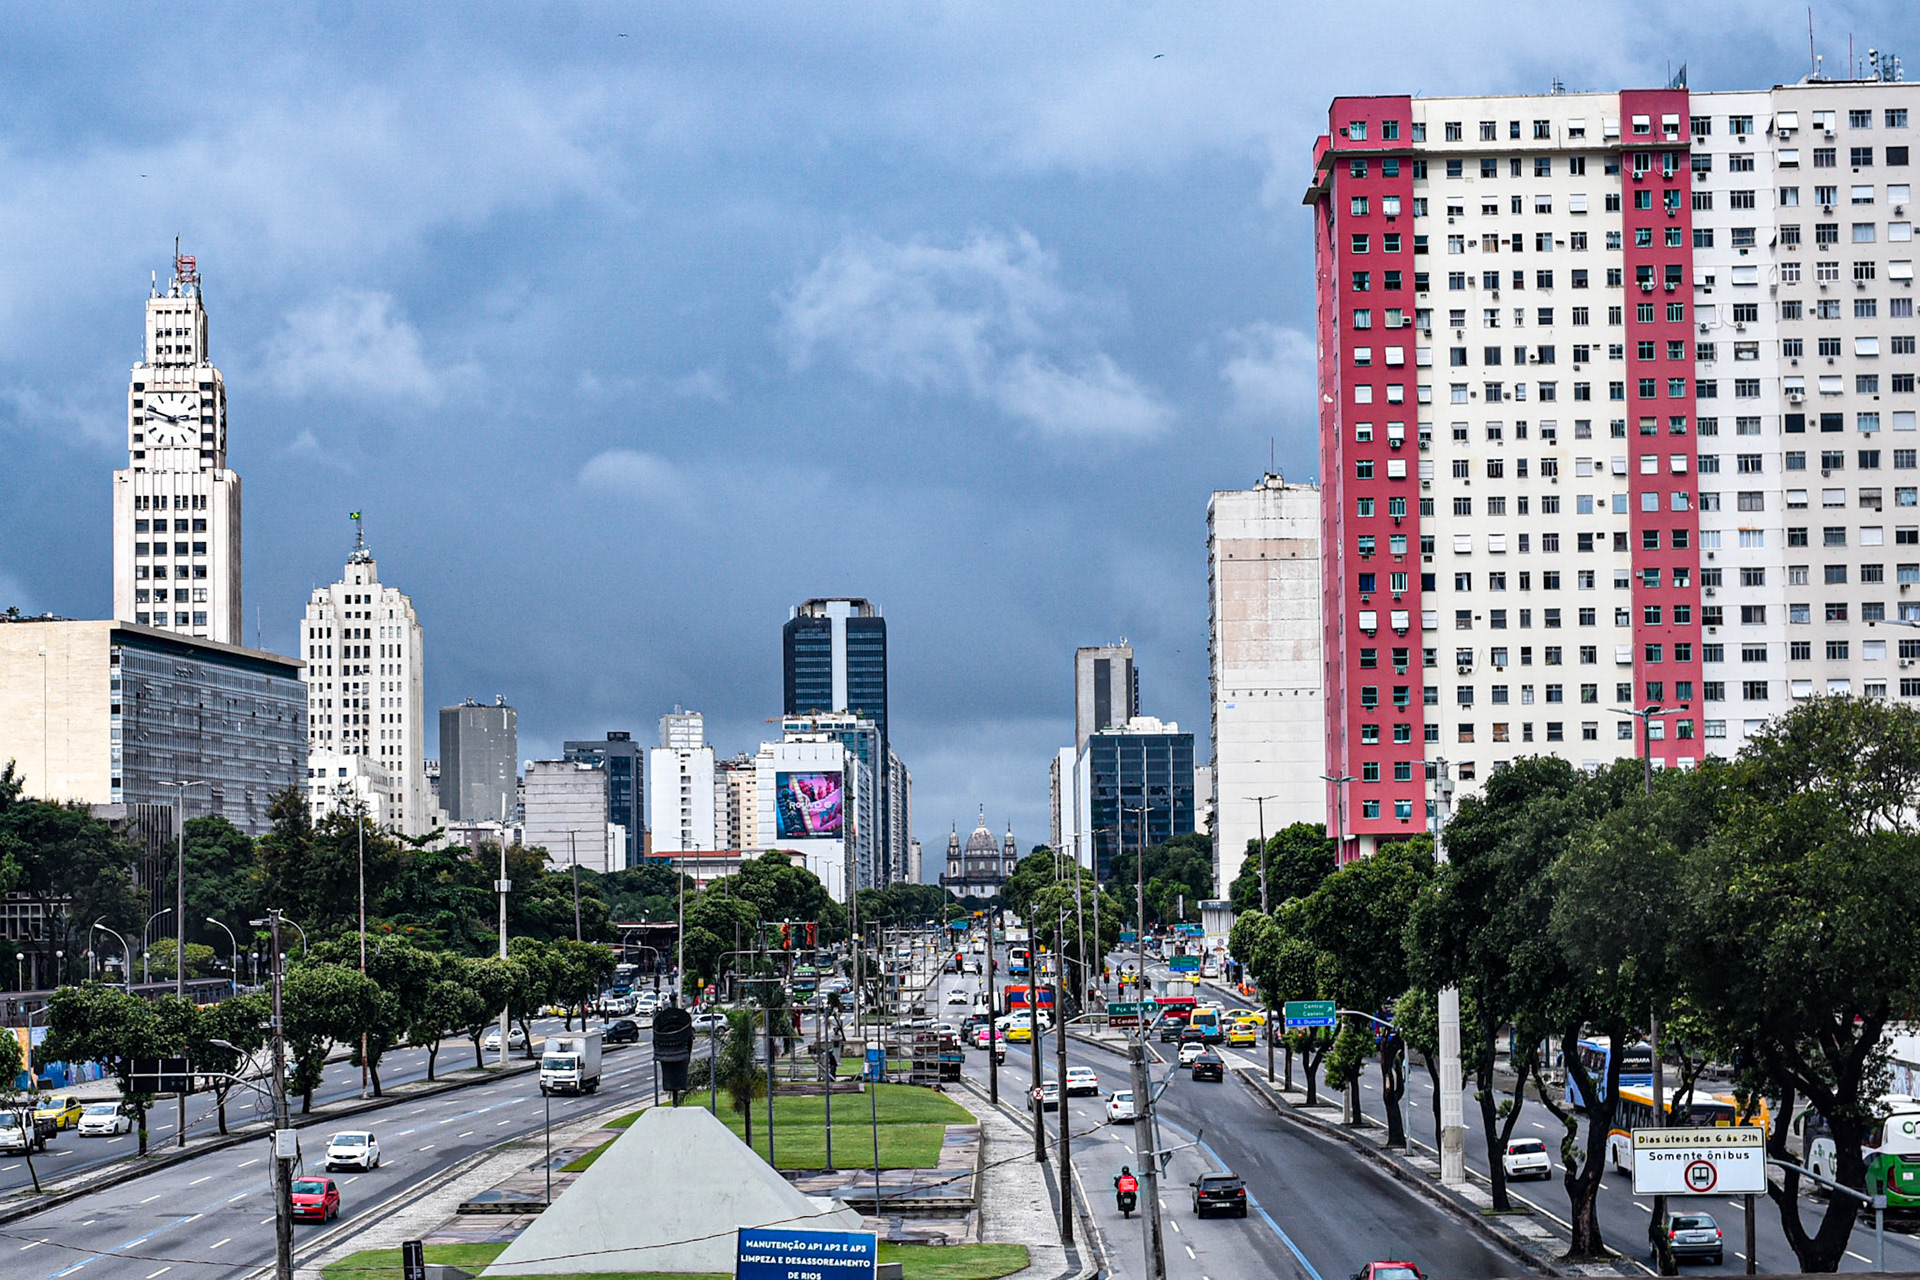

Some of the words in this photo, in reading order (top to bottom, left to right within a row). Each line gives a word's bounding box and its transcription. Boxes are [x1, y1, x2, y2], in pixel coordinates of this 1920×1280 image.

[1638, 1135, 1661, 1144] Dias
[1664, 1135, 1691, 1143] úteis
[1693, 1134, 1711, 1143] das
[1715, 1134, 1722, 1143] 6
[1742, 1133, 1758, 1142] 21h
[1649, 1151, 1703, 1161] Somente
[1707, 1150, 1750, 1160] ônibus
[745, 1240, 806, 1251] MANUTENÇÃO
[807, 1243, 823, 1251] AP1
[824, 1243, 841, 1252] AP2
[842, 1244, 848, 1252] E
[850, 1245, 867, 1253] AP3
[740, 1254, 776, 1264] LIMPEZA
[777, 1256, 783, 1264] E
[785, 1257, 871, 1268] DESASSOREAMENTO
[787, 1271, 799, 1279] DE
[801, 1272, 822, 1280] RIOS
